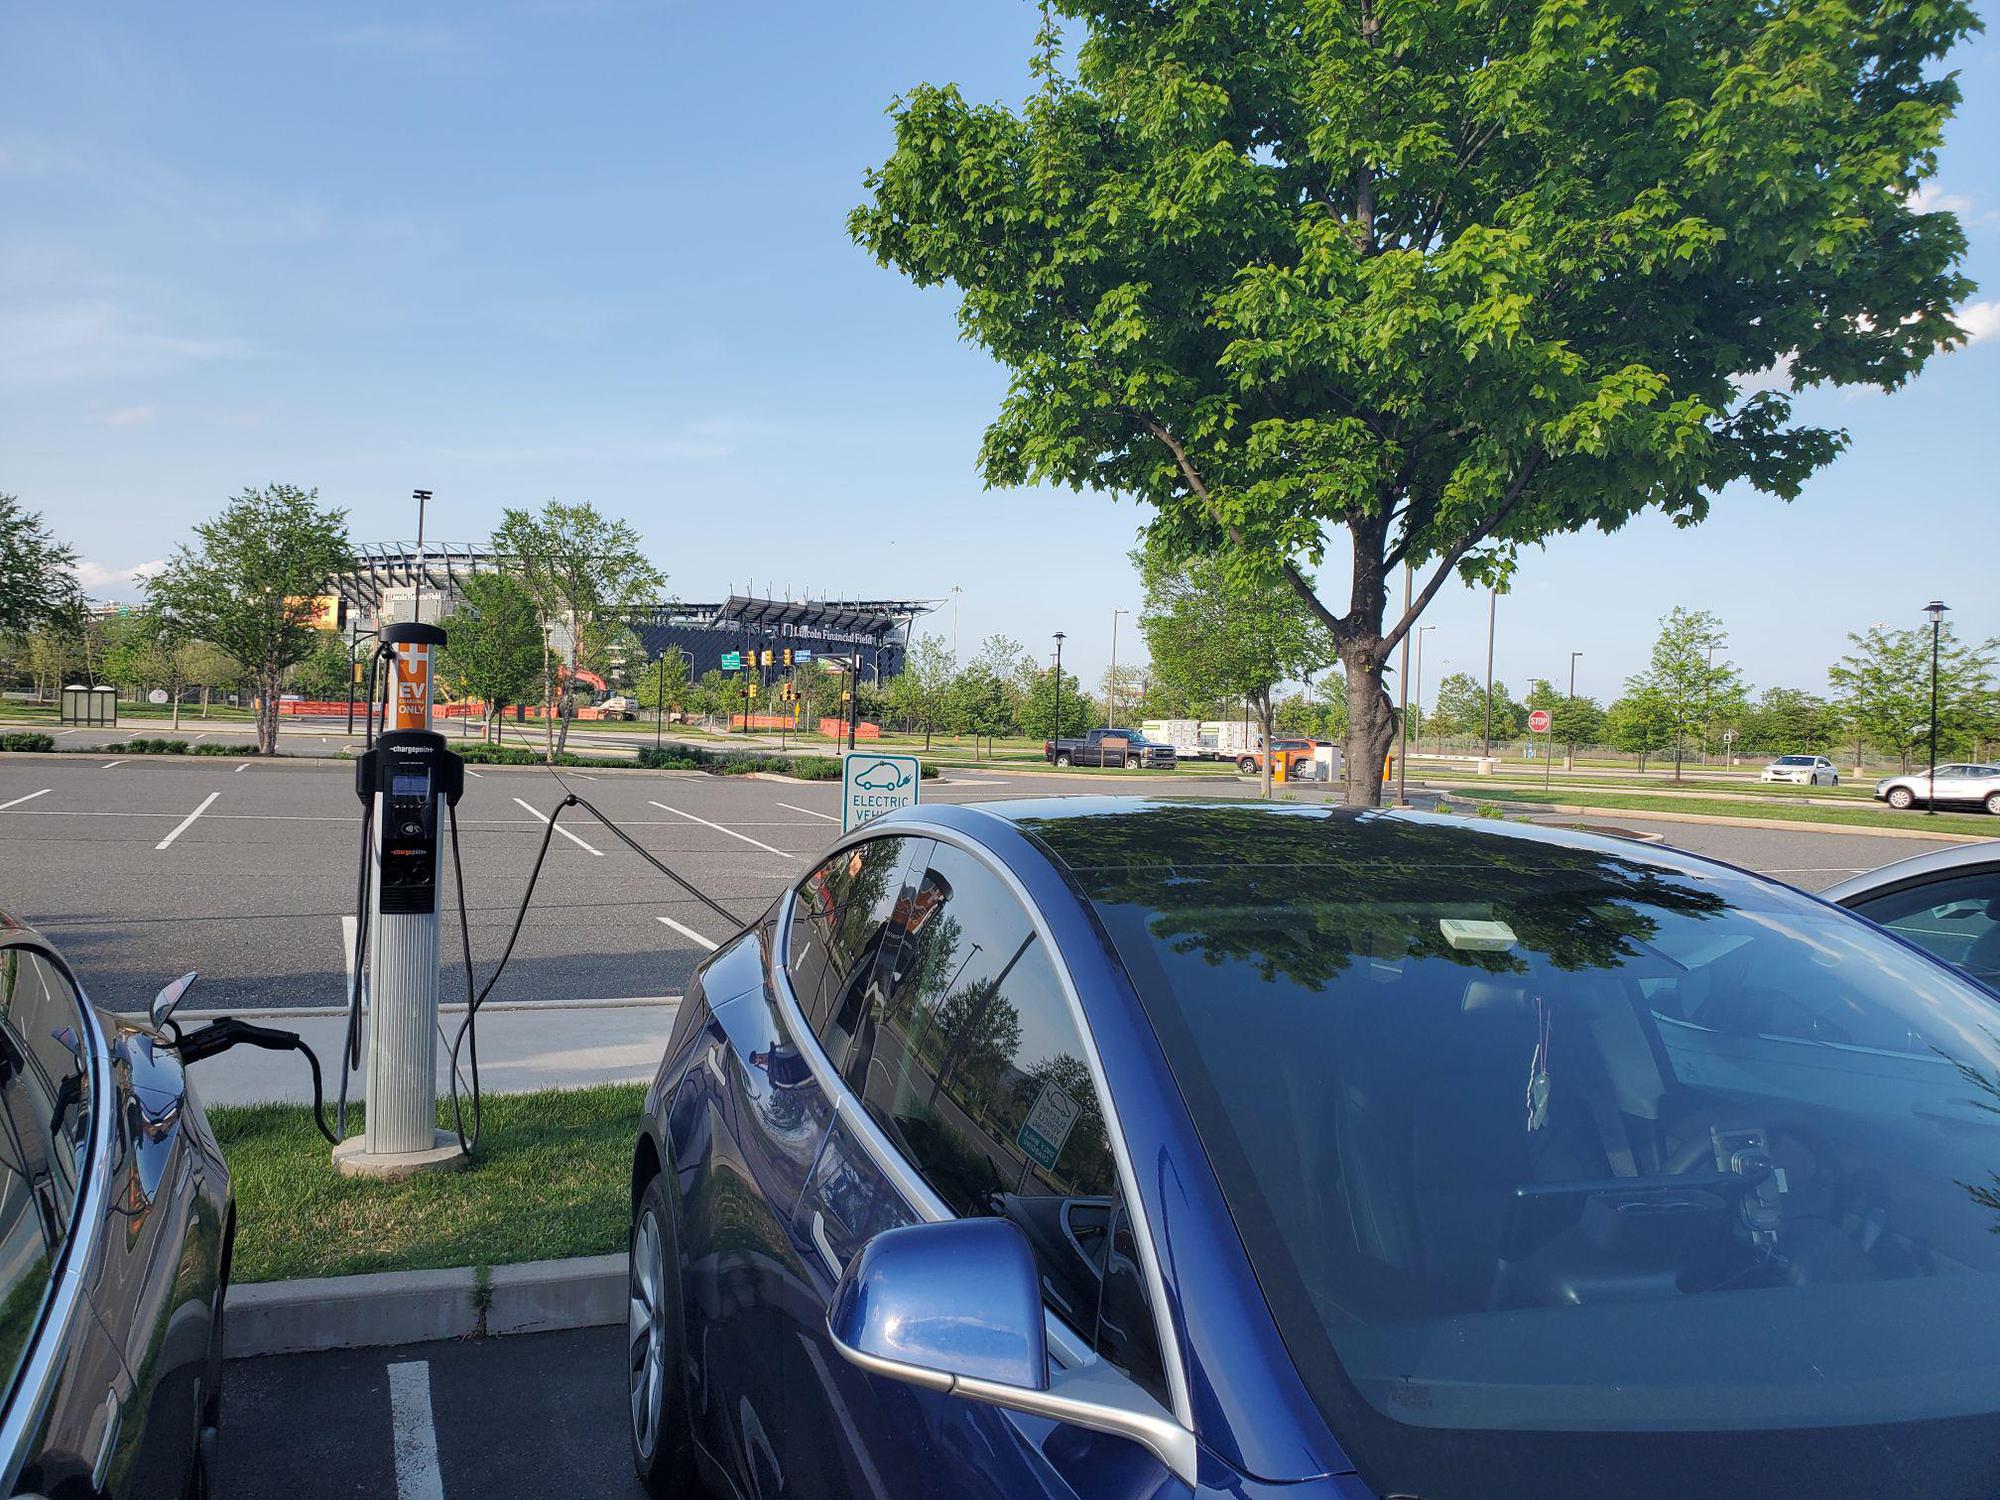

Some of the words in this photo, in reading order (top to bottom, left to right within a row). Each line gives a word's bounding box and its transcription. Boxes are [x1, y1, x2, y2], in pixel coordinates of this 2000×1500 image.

[794, 625, 822, 639] Lincoln
[822, 629, 854, 643] Financial
[855, 632, 873, 645] Field
[400, 682, 425, 698] EV
[399, 705, 425, 714] ONLY
[1530, 717, 1548, 726] STOP
[853, 795, 909, 808] ELECTRIC
